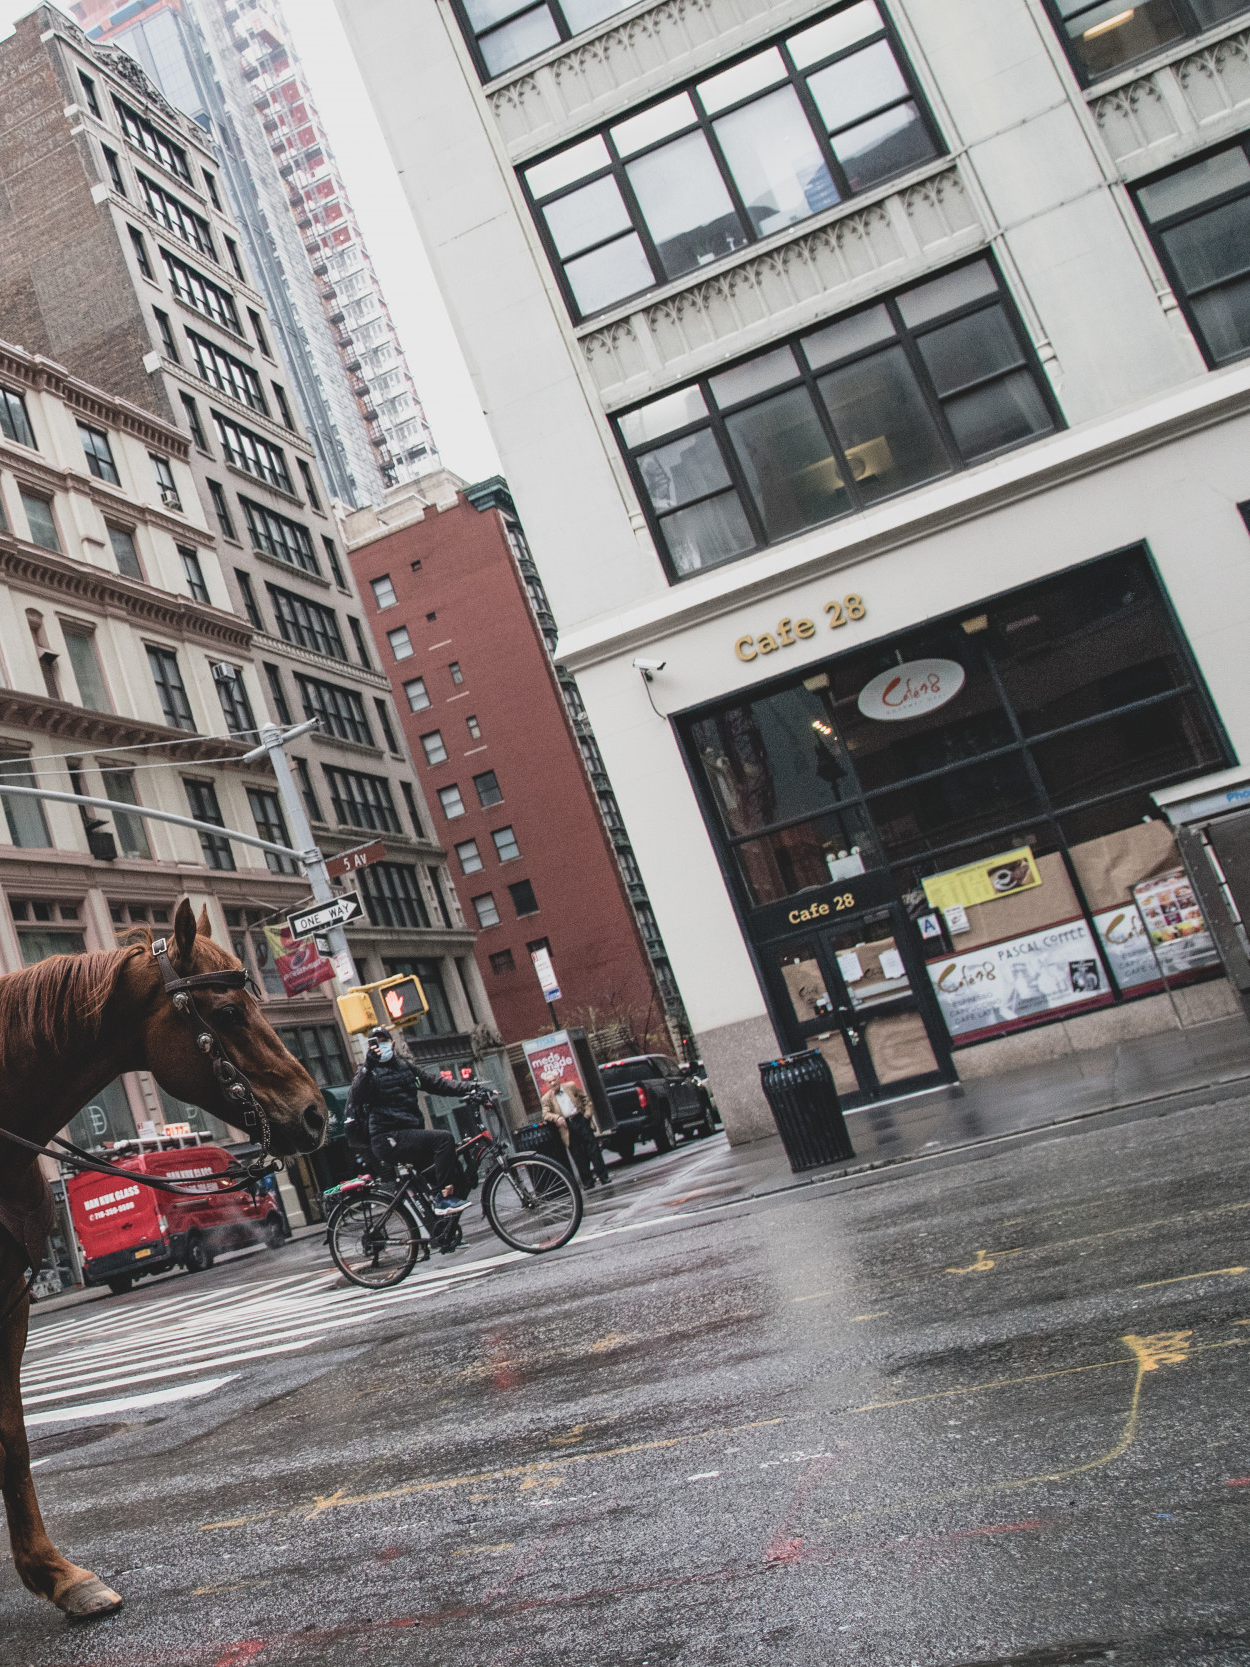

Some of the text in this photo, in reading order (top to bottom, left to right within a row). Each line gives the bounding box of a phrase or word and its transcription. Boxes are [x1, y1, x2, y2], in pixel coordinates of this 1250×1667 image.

[734, 593, 866, 661] Cafe 28
[343, 858, 351, 870] 5
[300, 902, 350, 930] ONE WAY
[788, 893, 855, 924] Cafe 28
[924, 919, 936, 933] A
[998, 941, 1040, 960] PASCAL
[532, 1052, 560, 1068] meds
[544, 1056, 573, 1072] made
[115, 1185, 140, 1201] GLASS
